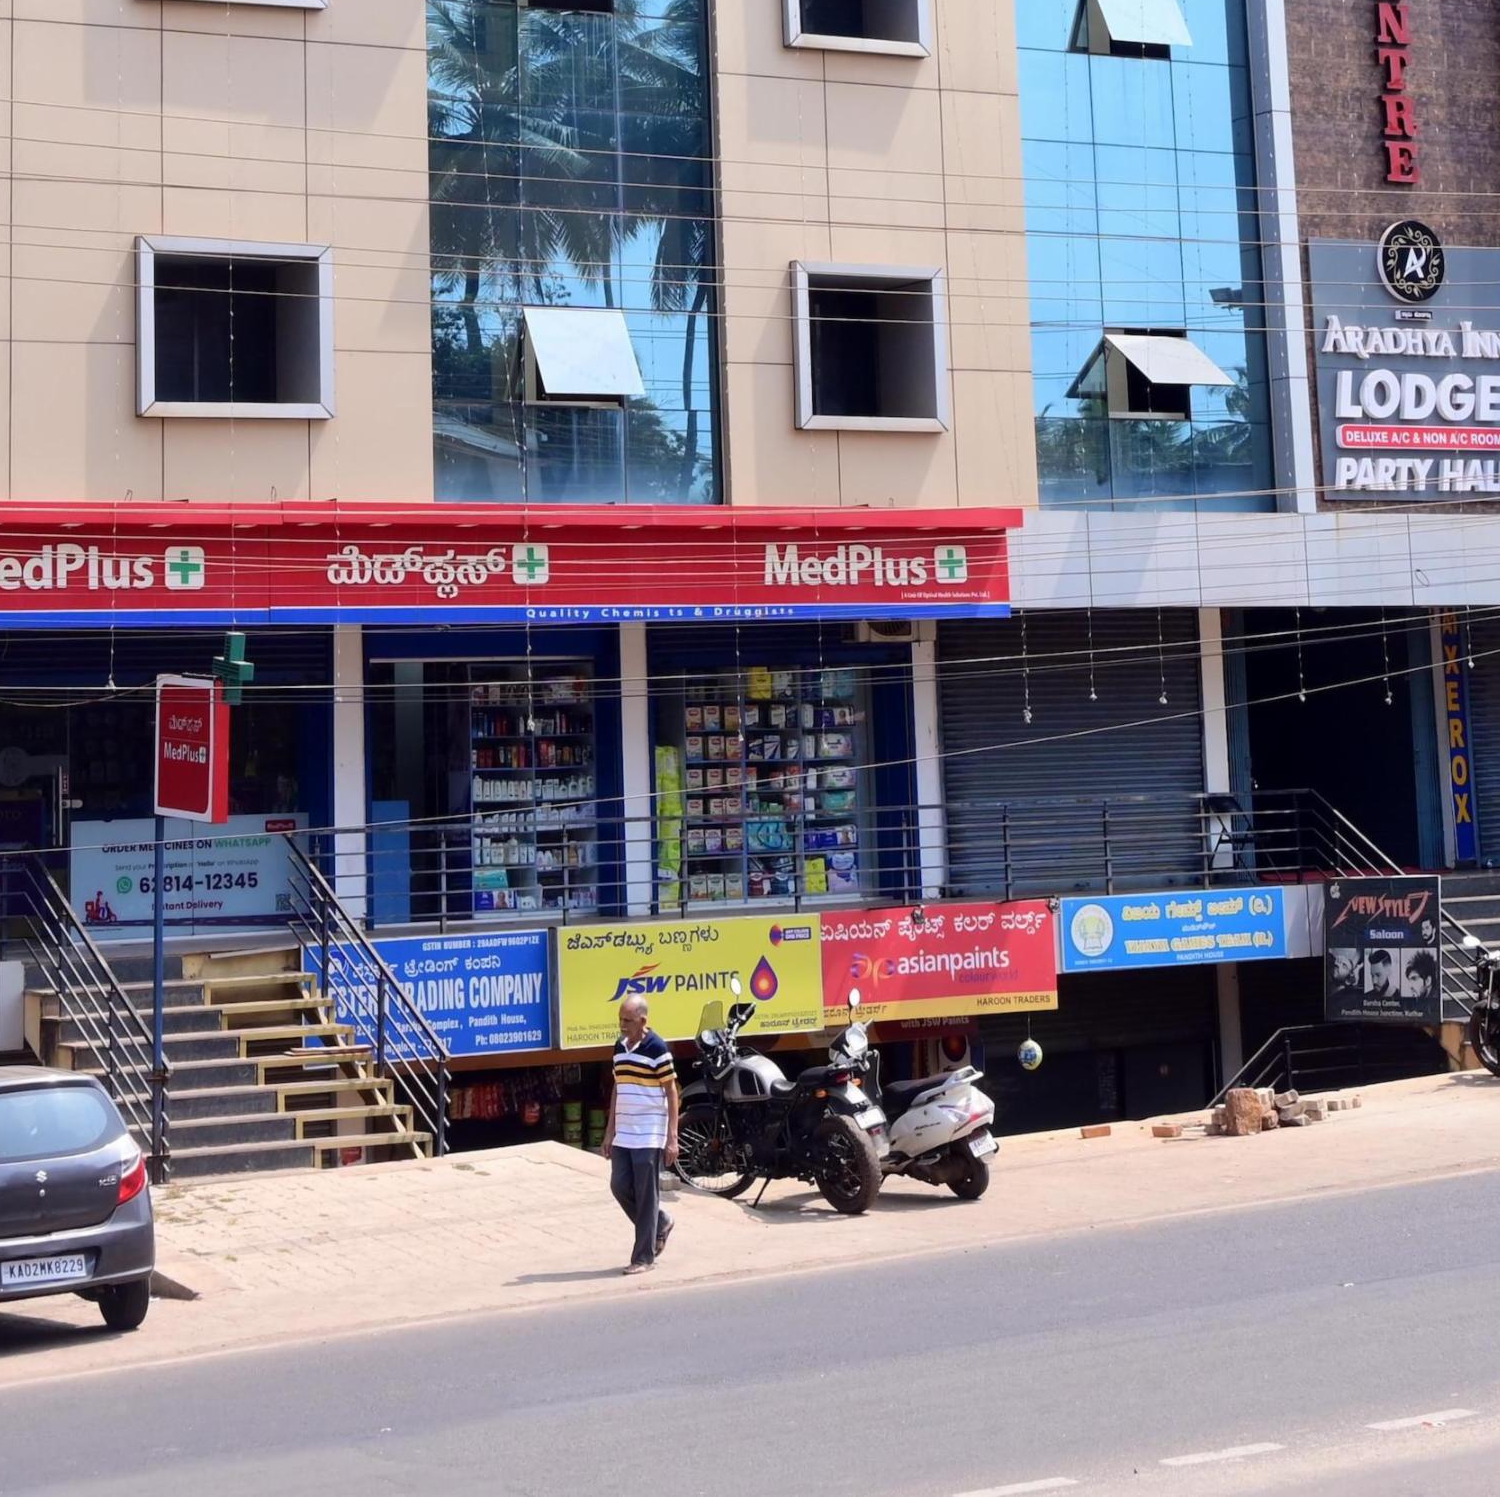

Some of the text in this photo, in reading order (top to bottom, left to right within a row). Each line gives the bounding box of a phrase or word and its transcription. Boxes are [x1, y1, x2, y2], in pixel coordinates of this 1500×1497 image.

[1321, 315, 1458, 359] ARADHYA
[1346, 432, 1389, 444] DELUXE
[1391, 433, 1411, 444] A/C
[1413, 433, 1421, 444] &
[1423, 433, 1447, 444] NON
[1450, 434, 1468, 445] A/C
[1334, 457, 1434, 491] PARTY
[763, 542, 927, 586] MedPlus
[526, 607, 590, 620] Quality
[714, 605, 795, 618] Druggists
[1444, 644, 1471, 824] XEROX
[163, 742, 199, 763] MedPlus
[196, 839, 212, 849] ON
[214, 836, 271, 848] WHATSAPP
[186, 900, 223, 911] Delivery
[953, 911, 996, 933] ಕಲರ್
[658, 925, 719, 952] ಬಣ್ಣಗಳು
[1369, 929, 1404, 940] Saloon
[896, 946, 1010, 981] asianpaints
[469, 972, 543, 1009] COMPANY
[607, 975, 672, 1002] JSW
[976, 994, 1051, 1007] HAROON TRADERS
[469, 1015, 498, 1028] Pandith
[500, 1013, 527, 1025] House,
[942, 1015, 969, 1026] Paints
[475, 1033, 488, 1046] Ph:
[9, 1259, 84, 1279] KA02MK8229
